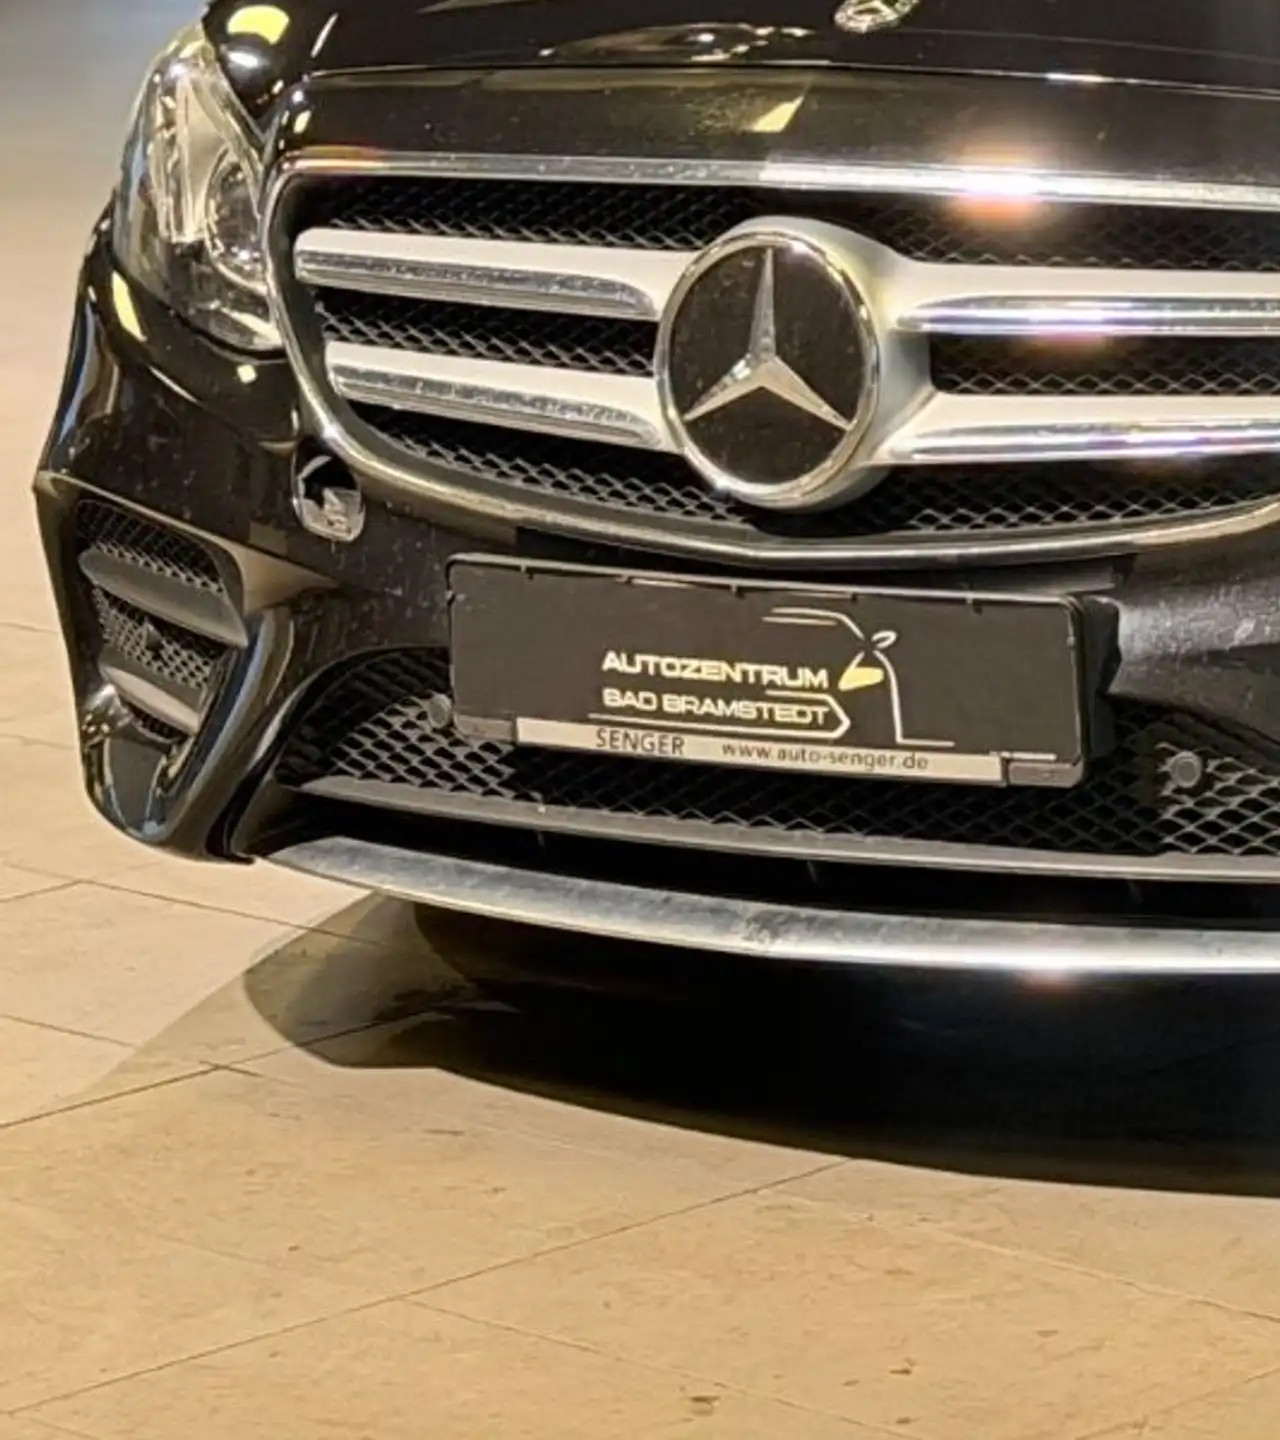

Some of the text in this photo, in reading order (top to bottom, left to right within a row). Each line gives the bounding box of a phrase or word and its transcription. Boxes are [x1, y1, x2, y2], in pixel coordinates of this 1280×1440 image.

[602, 650, 829, 689] AUTOZENTRUM
[602, 688, 829, 725] BAD BRAMSTEDT
[595, 727, 929, 771] SENGER www.auto-senger.de
